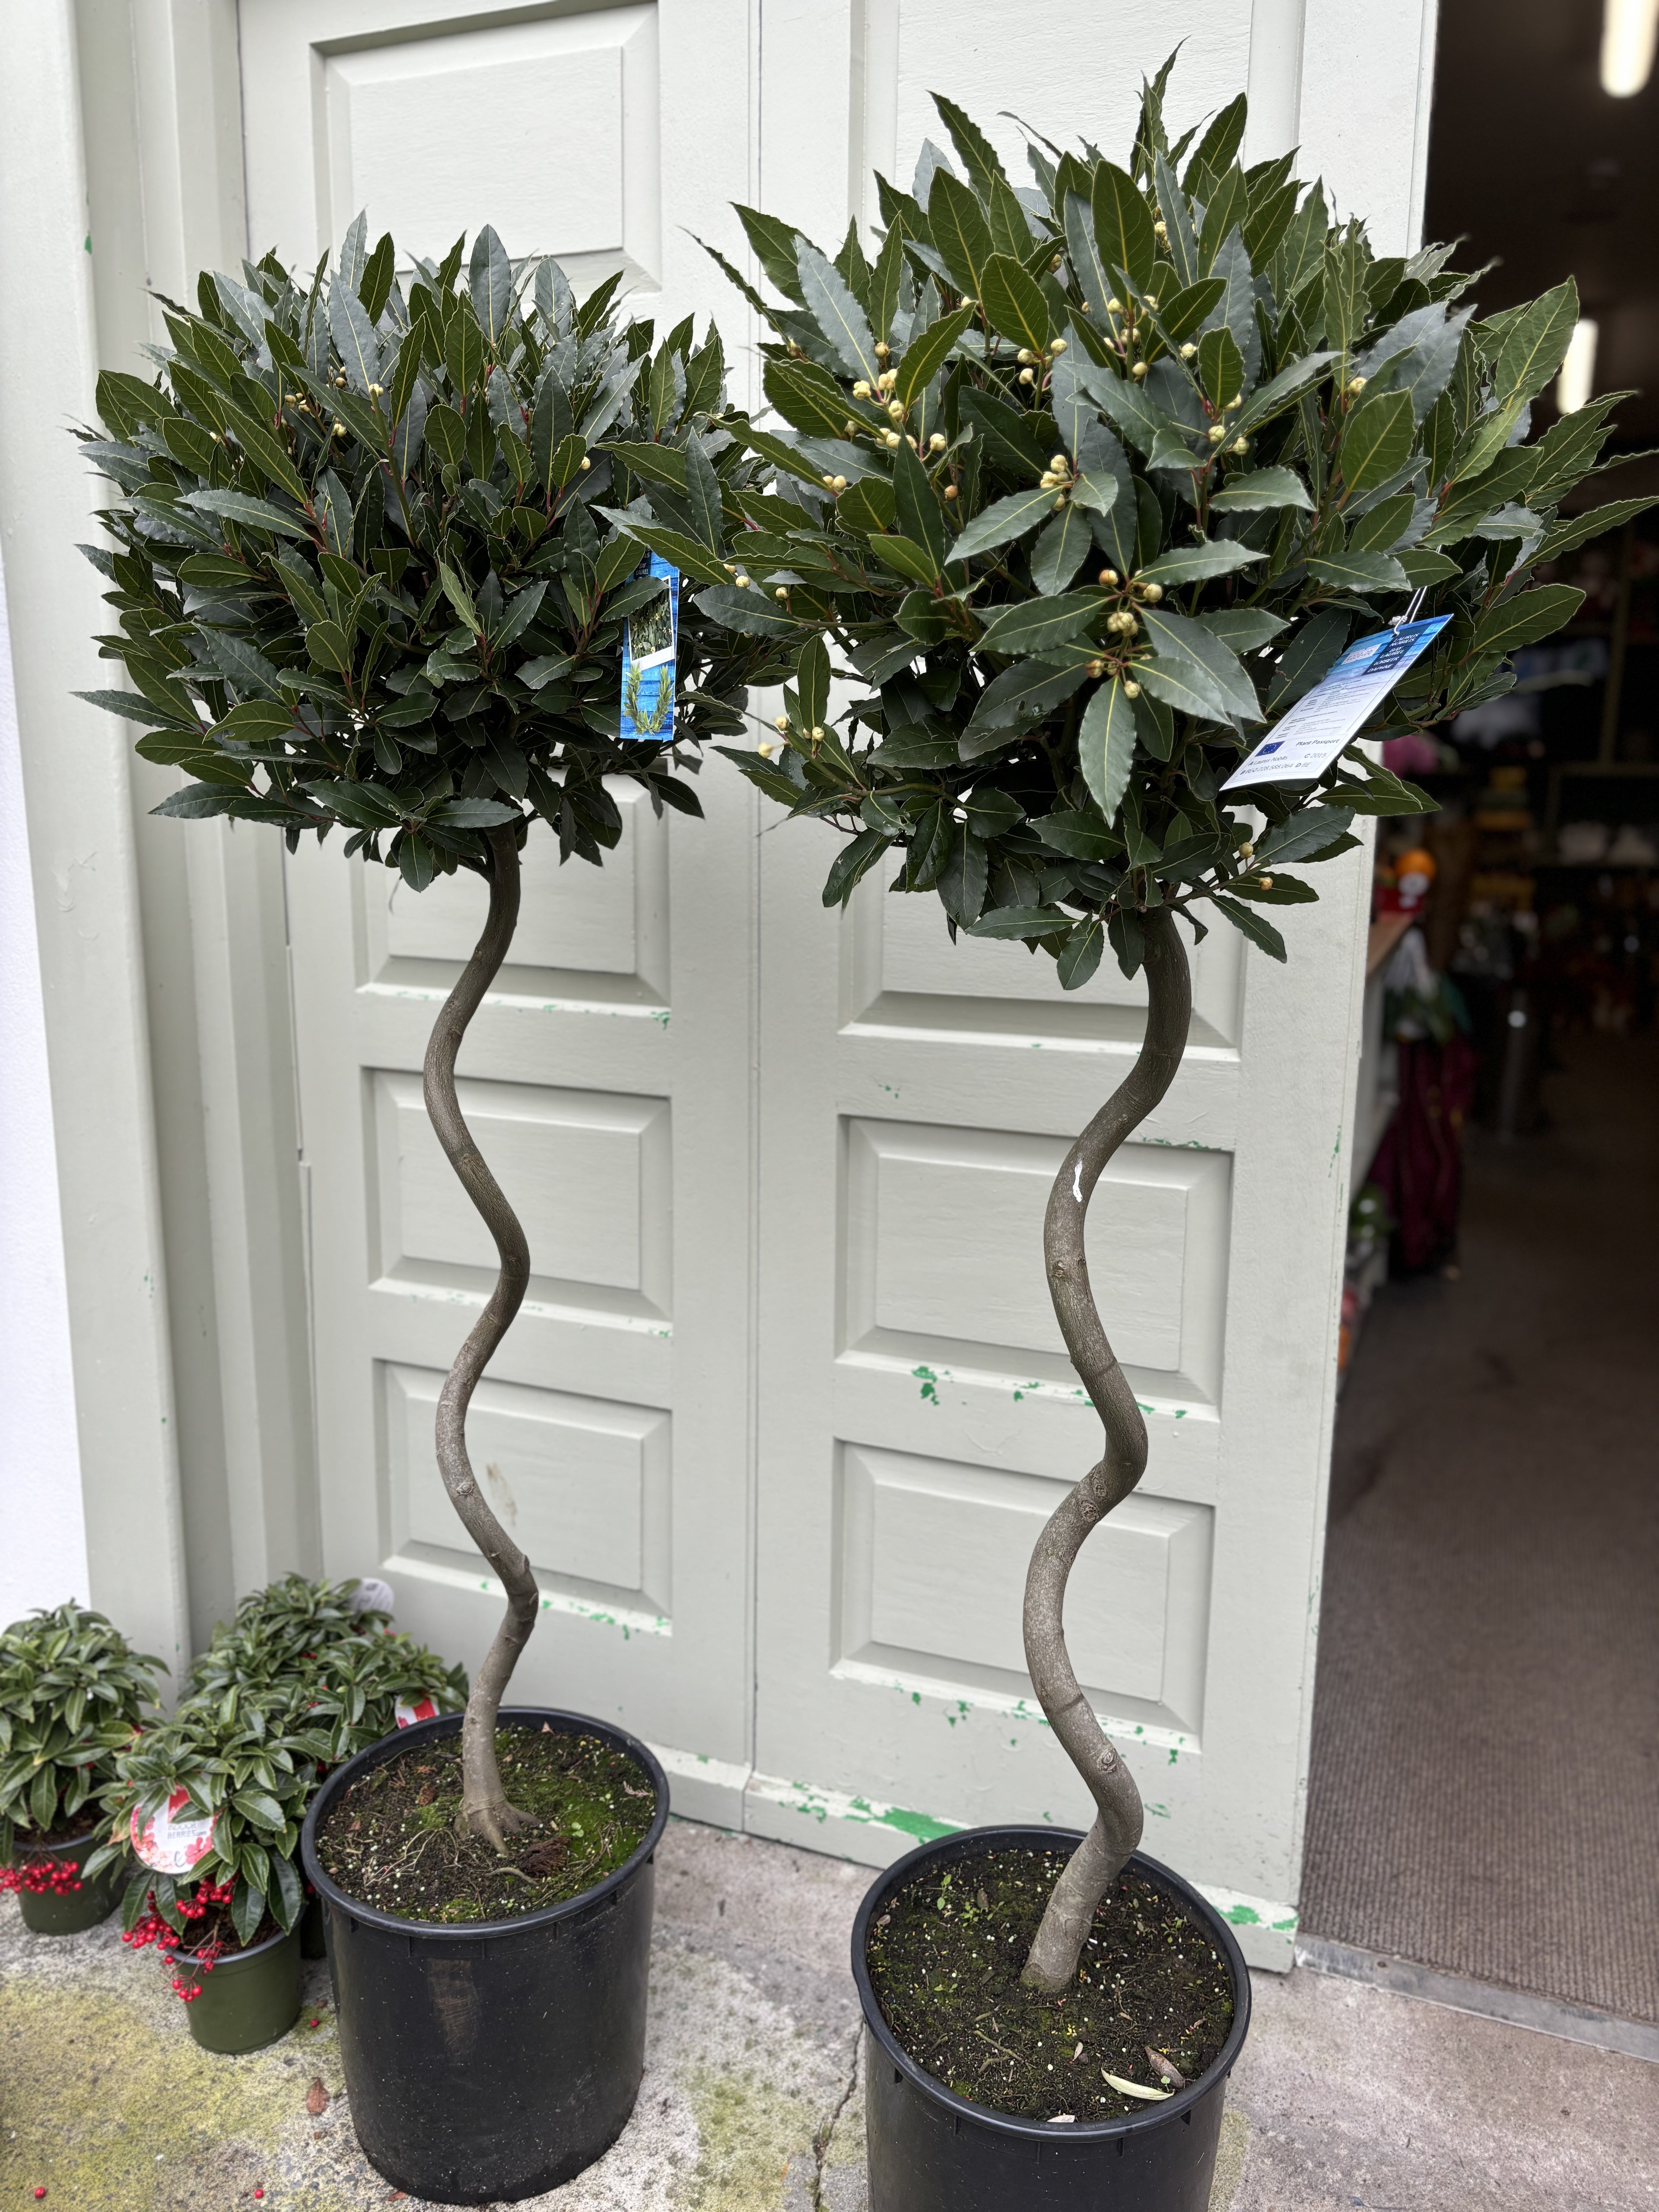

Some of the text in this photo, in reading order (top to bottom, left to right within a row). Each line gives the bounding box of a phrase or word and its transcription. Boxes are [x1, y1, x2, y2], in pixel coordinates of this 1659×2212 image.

[1393, 633, 1420, 643] LAURUS
[1389, 639, 1415, 647] NOBILIS
[1380, 650, 1404, 658] LAUREL
[1373, 656, 1399, 666] LORBEER
[1367, 664, 1394, 673] DAPHNE
[168, 1822, 196, 1831] INDOOR
